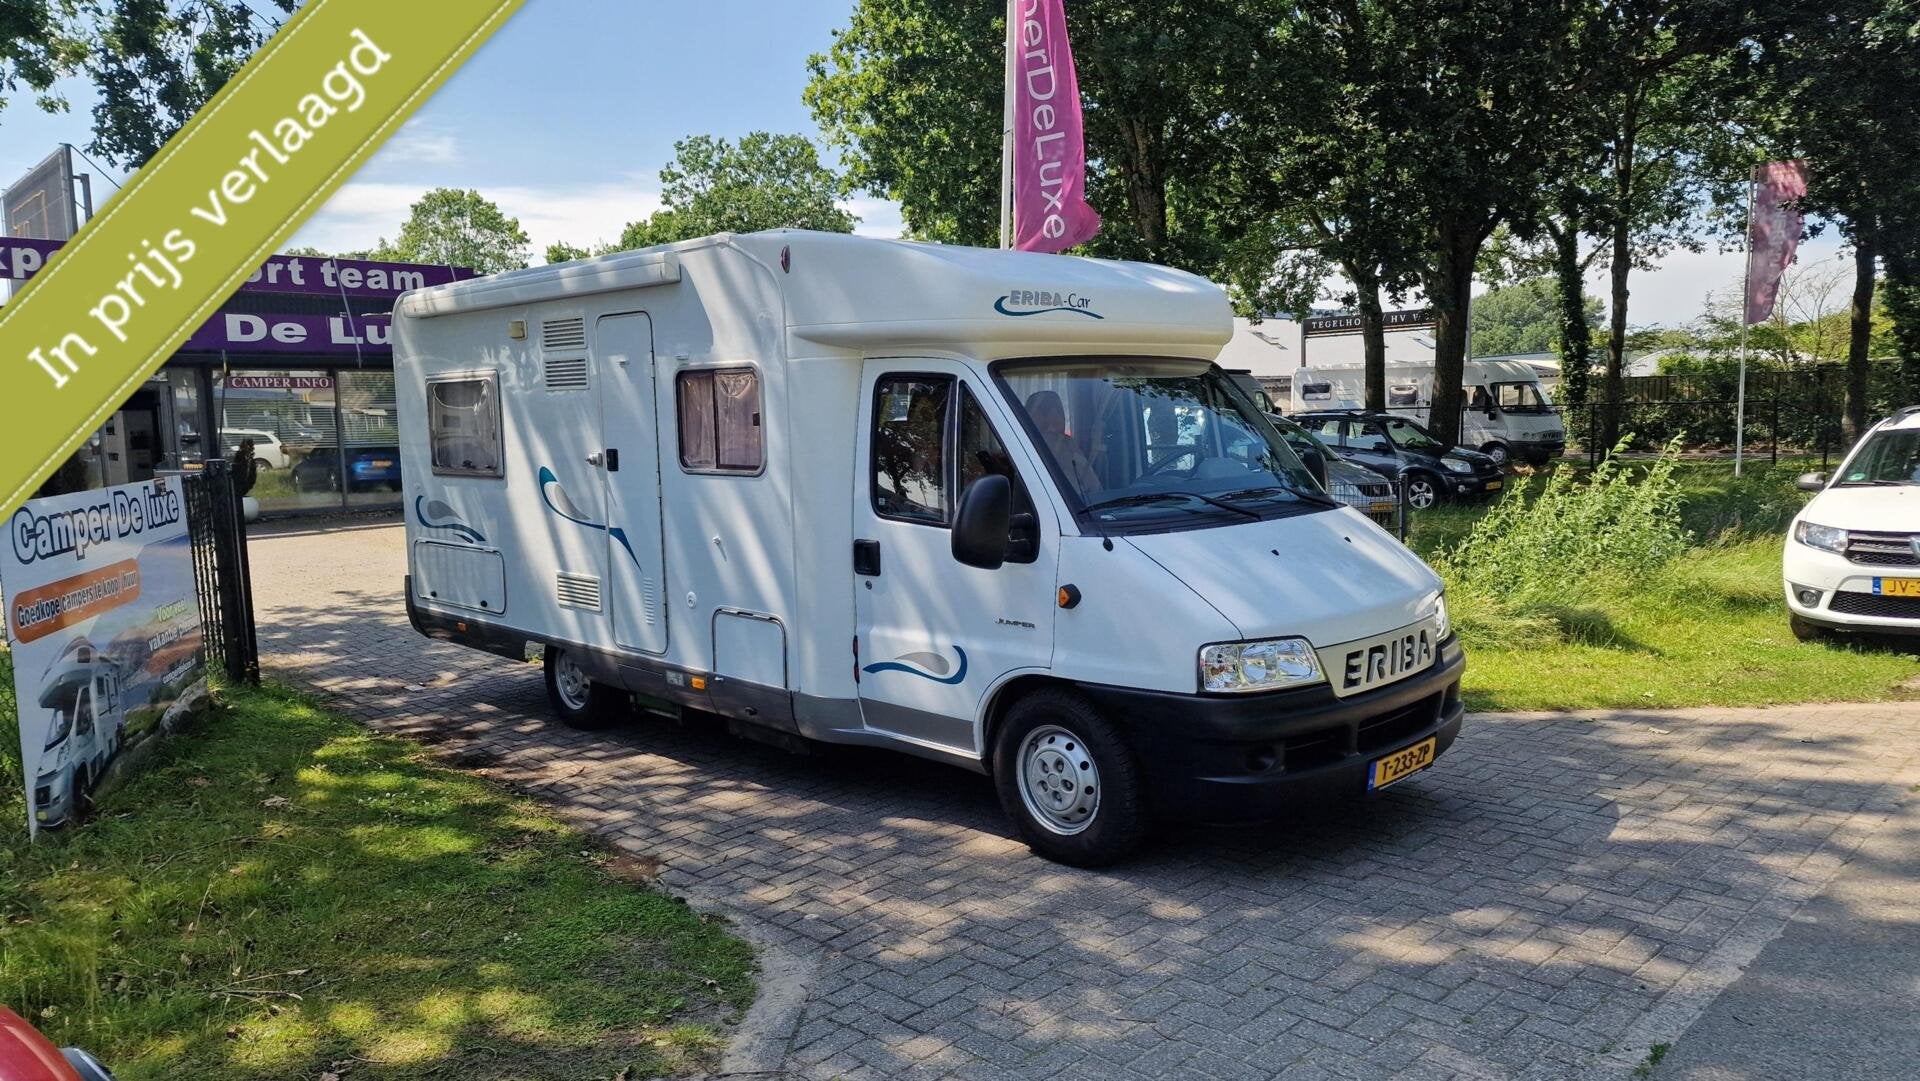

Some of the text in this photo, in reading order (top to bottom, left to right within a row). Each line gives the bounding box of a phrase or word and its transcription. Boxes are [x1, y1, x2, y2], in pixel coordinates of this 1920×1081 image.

[320, 259, 425, 290] team
[1009, 290, 1091, 308] ERIBA-Car
[225, 313, 308, 344] De
[231, 377, 330, 389] CAMPER INFO
[12, 503, 111, 565] Camper
[113, 490, 143, 538] De
[17, 598, 60, 628] Goedkope
[61, 587, 94, 612] campers
[95, 584, 102, 600] te
[102, 577, 119, 599] koop
[994, 618, 1036, 629] JUMPER
[1343, 629, 1431, 689] ERIBA
[1381, 743, 1431, 780] T-233-ZP
